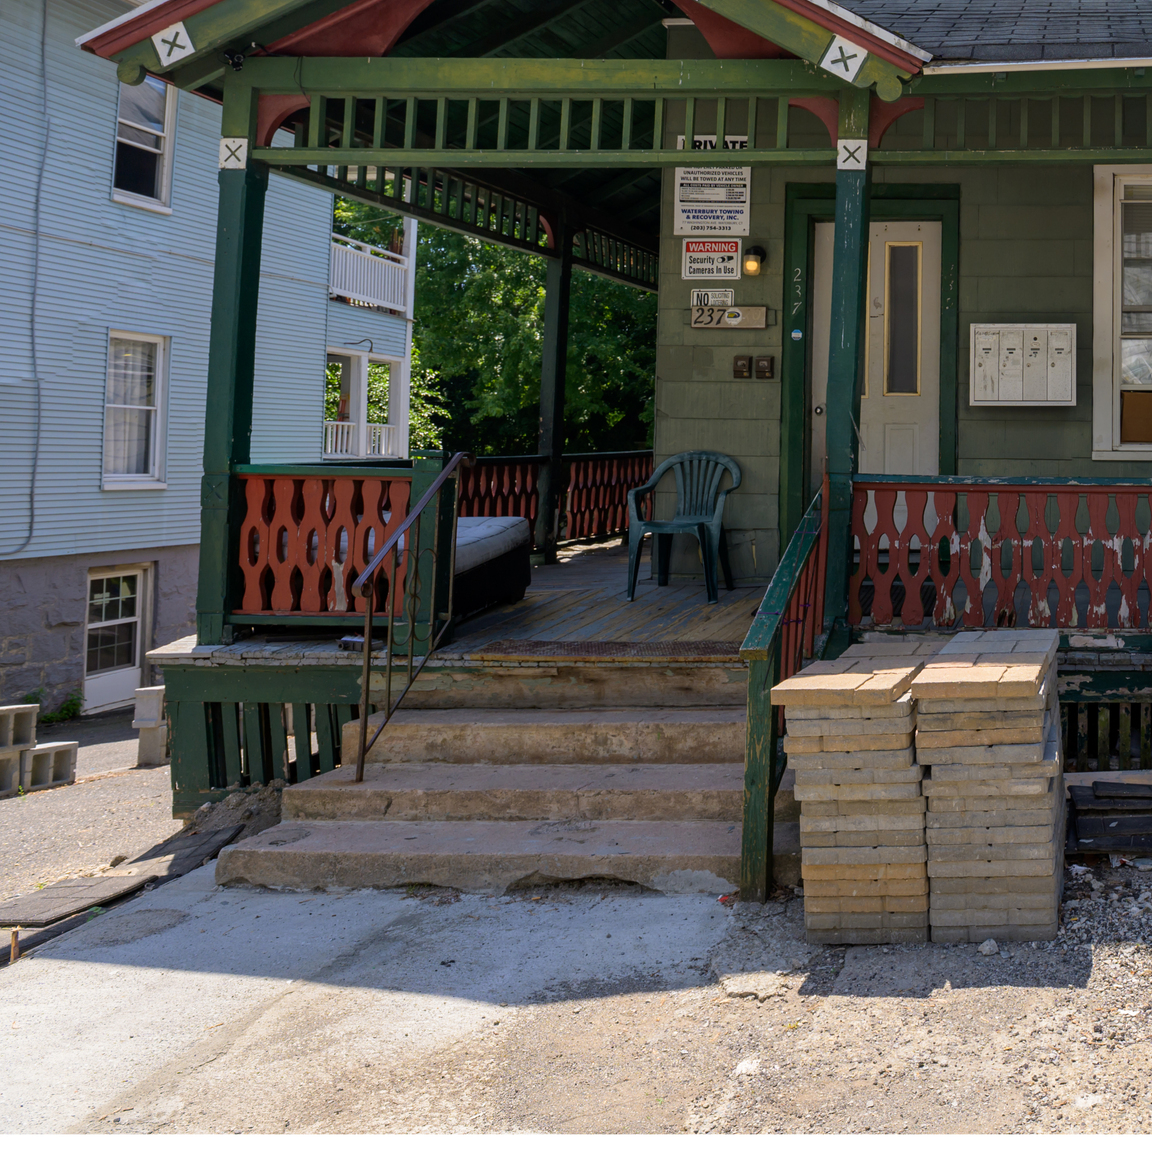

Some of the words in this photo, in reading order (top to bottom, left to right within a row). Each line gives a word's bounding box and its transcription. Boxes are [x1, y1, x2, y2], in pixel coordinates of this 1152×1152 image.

[682, 139, 748, 150] RIVATE
[688, 243, 736, 252] WARNING
[688, 255, 715, 265] Security
[688, 265, 715, 275] Cameras
[715, 265, 722, 275] In
[723, 265, 735, 275] Use
[696, 292, 710, 306] NO
[693, 307, 727, 326] 237
